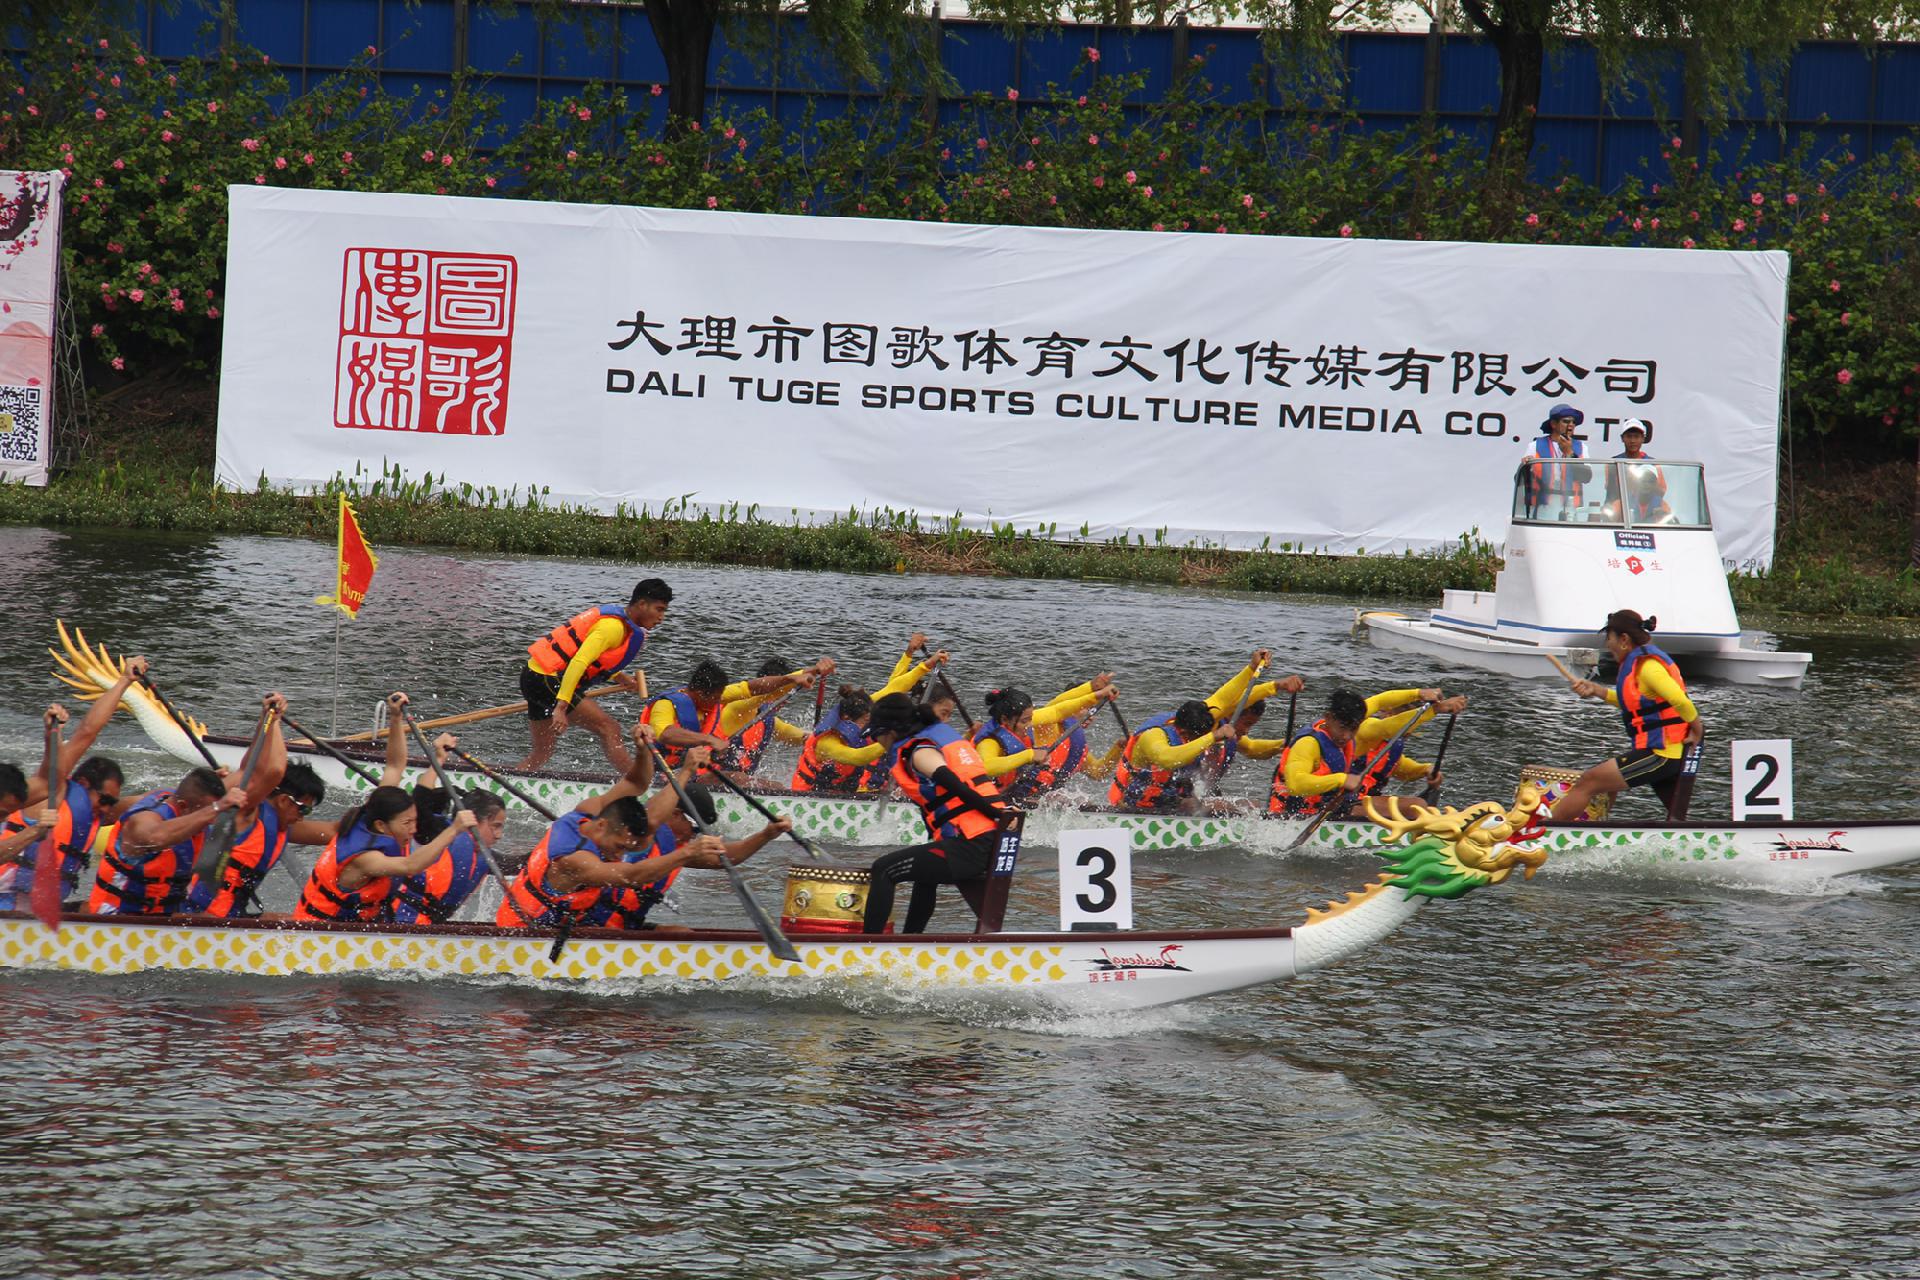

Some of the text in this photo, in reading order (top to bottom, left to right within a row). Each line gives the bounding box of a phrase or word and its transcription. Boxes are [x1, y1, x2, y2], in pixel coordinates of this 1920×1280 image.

[608, 311, 1656, 403] 大理市图歌体育文化传媒有限公司
[606, 368, 706, 398] DALI
[728, 376, 841, 406] TUGE
[861, 384, 1035, 416] SPORTS
[1055, 393, 1259, 427] CULTURE
[1279, 404, 1422, 435] MEDIA
[1745, 753, 1780, 807] 2
[1075, 846, 1117, 913] 3
